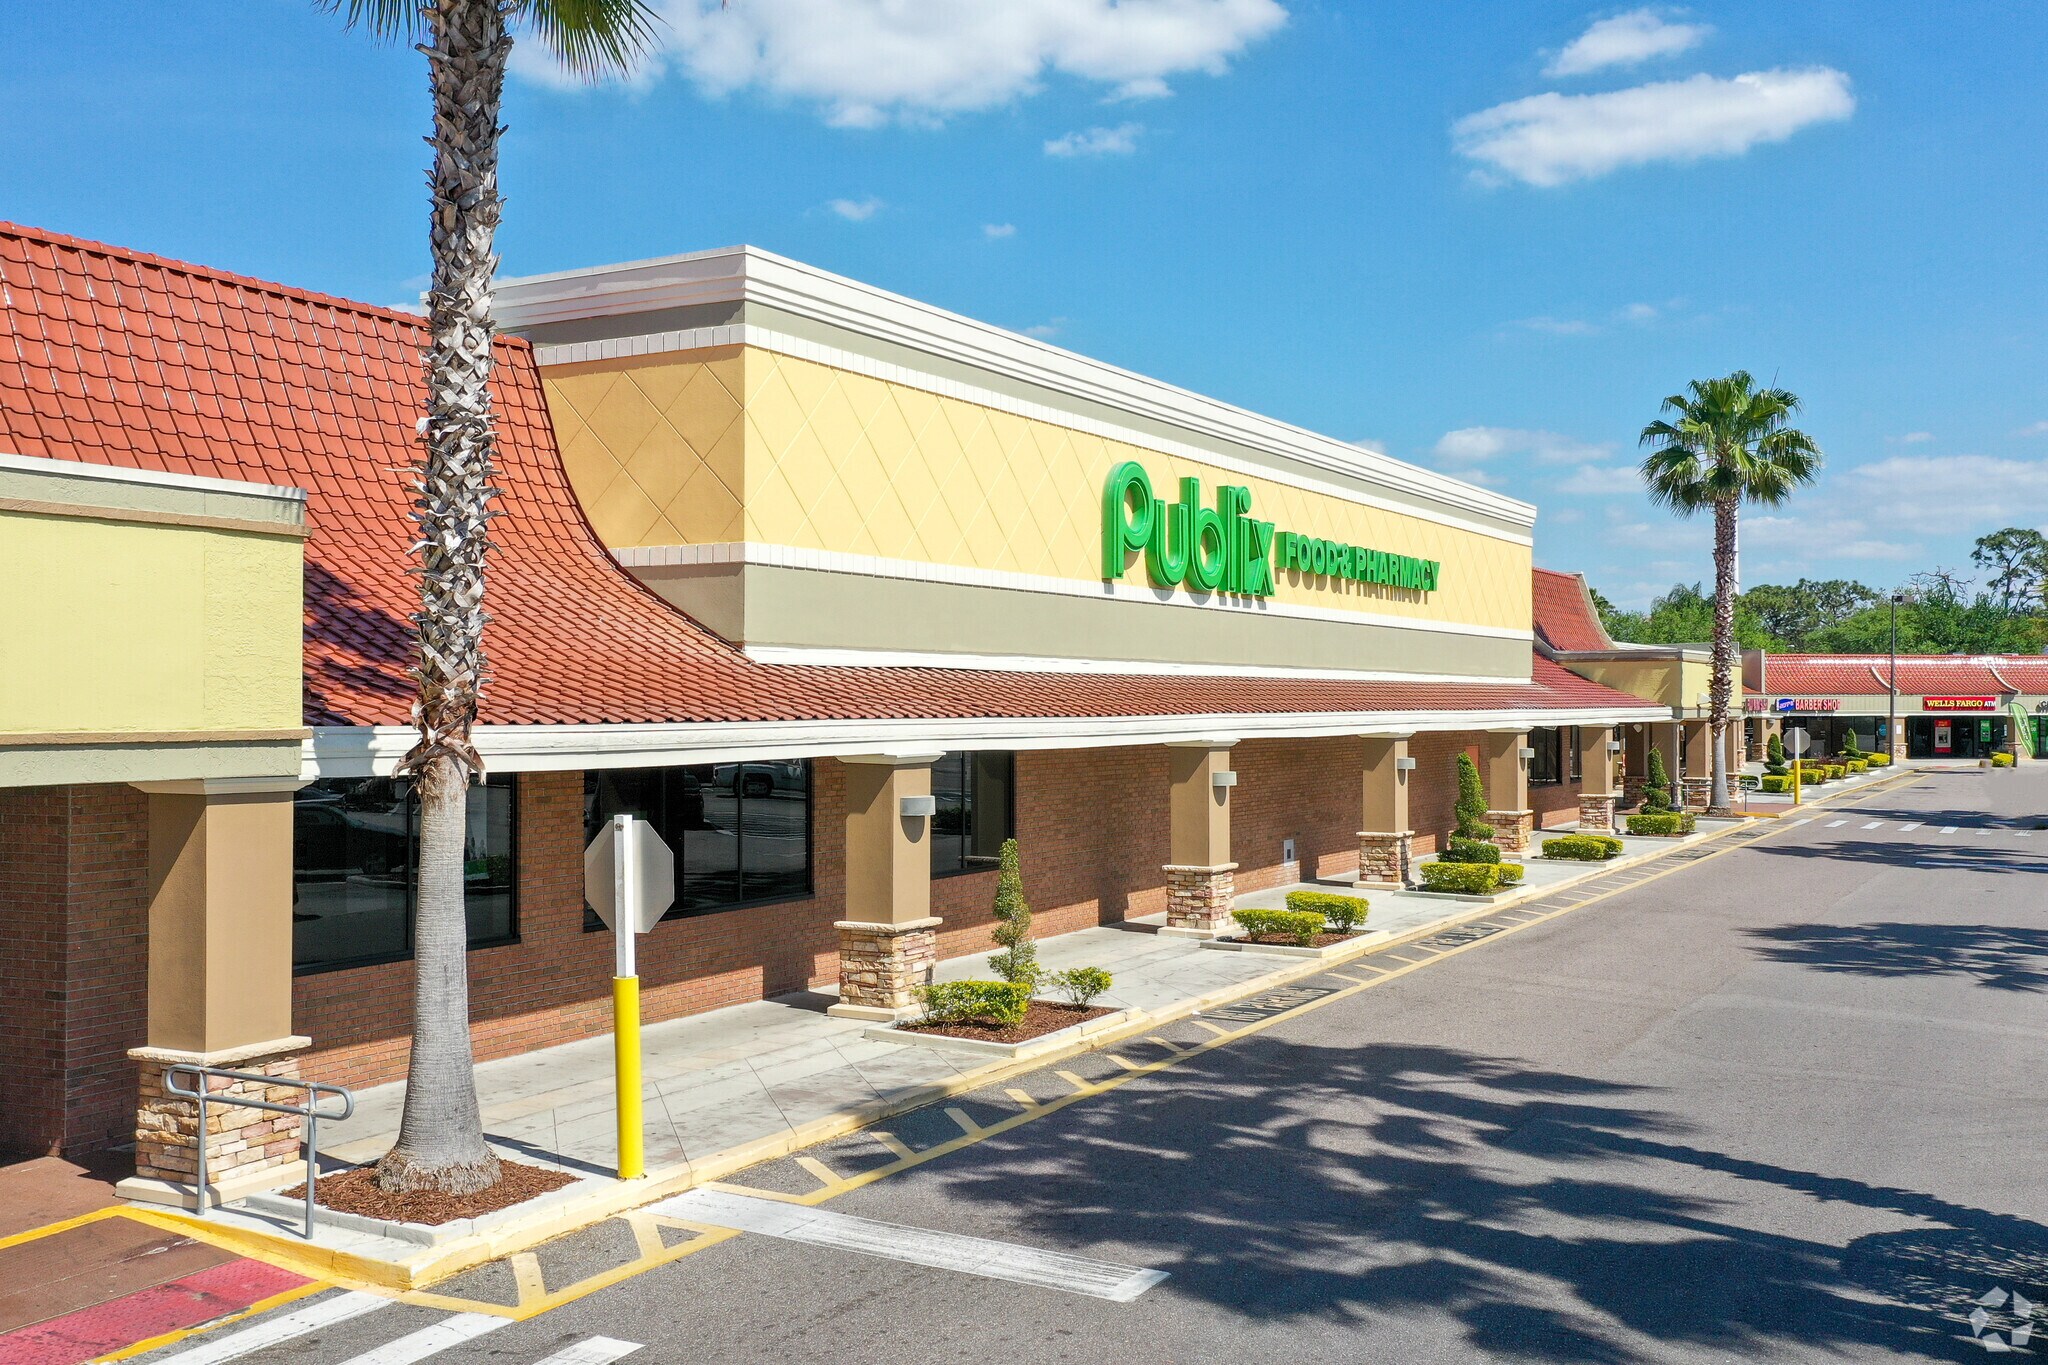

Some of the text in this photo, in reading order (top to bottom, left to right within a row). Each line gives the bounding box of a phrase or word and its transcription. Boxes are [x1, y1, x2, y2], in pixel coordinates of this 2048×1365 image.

[1102, 461, 1440, 597] Publix FOOD & PHARMACY
[1795, 699, 1822, 710] BARBER
[1823, 699, 1840, 710] SHOP
